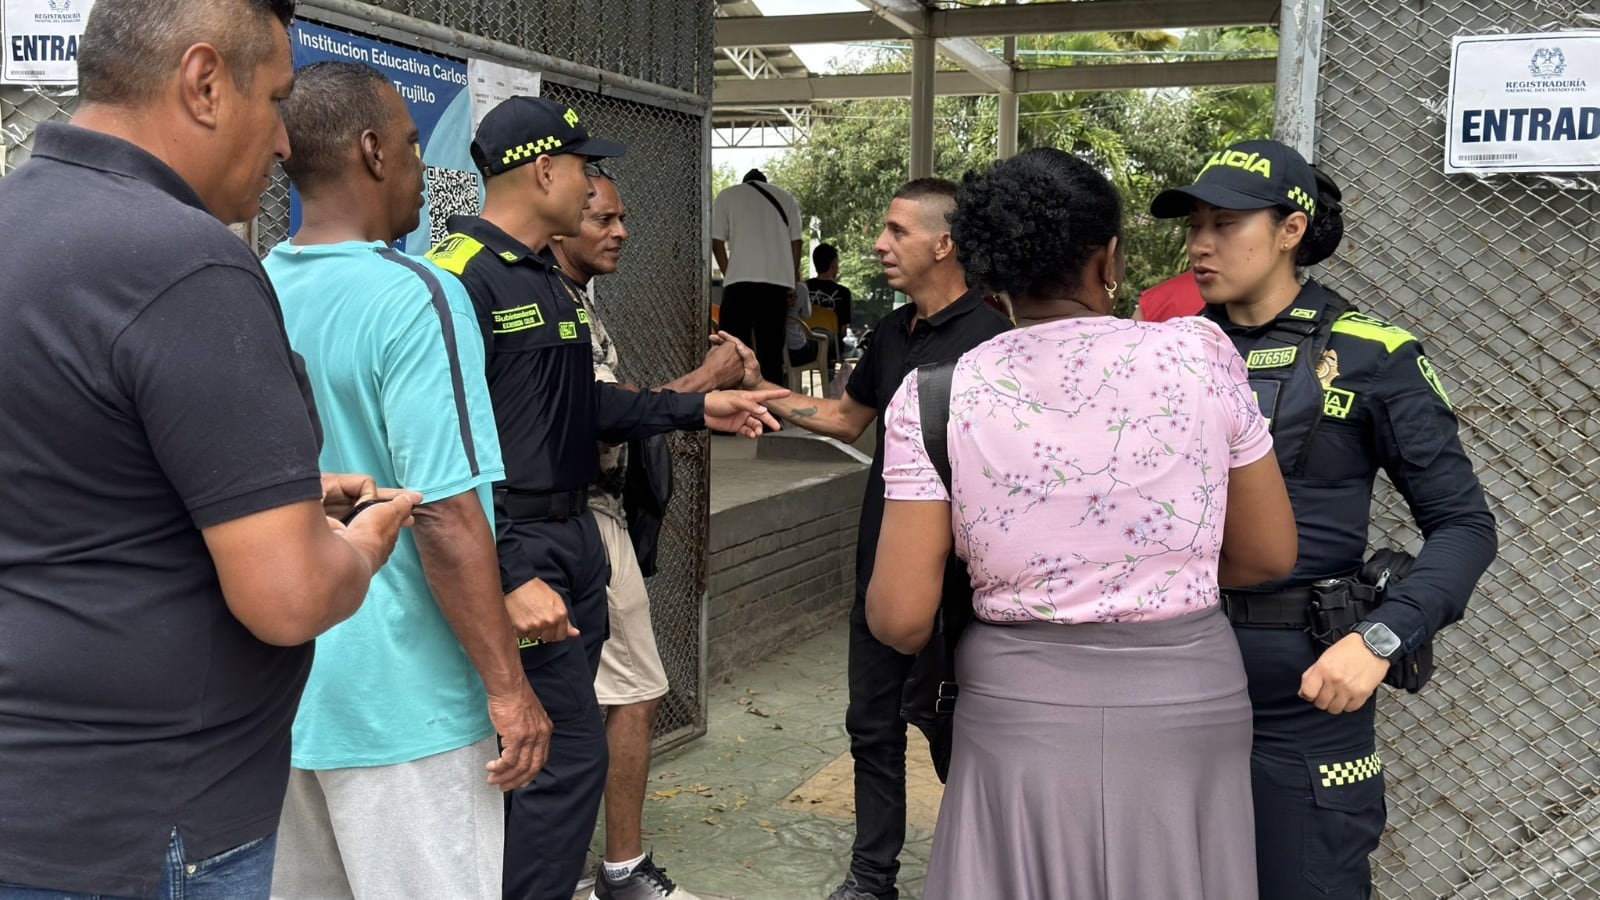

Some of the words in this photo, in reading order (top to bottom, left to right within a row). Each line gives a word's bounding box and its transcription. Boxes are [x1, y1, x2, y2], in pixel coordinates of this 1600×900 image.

[11, 35, 84, 61] ENTRA
[298, 28, 369, 61] Institucion
[371, 48, 430, 77] Educativa
[433, 64, 467, 86] Carlos
[394, 80, 436, 104] Trujillo
[1505, 79, 1587, 88] REGISTRADURÍA
[1194, 149, 1271, 182] LICÍA
[1251, 350, 1292, 366] 076515
